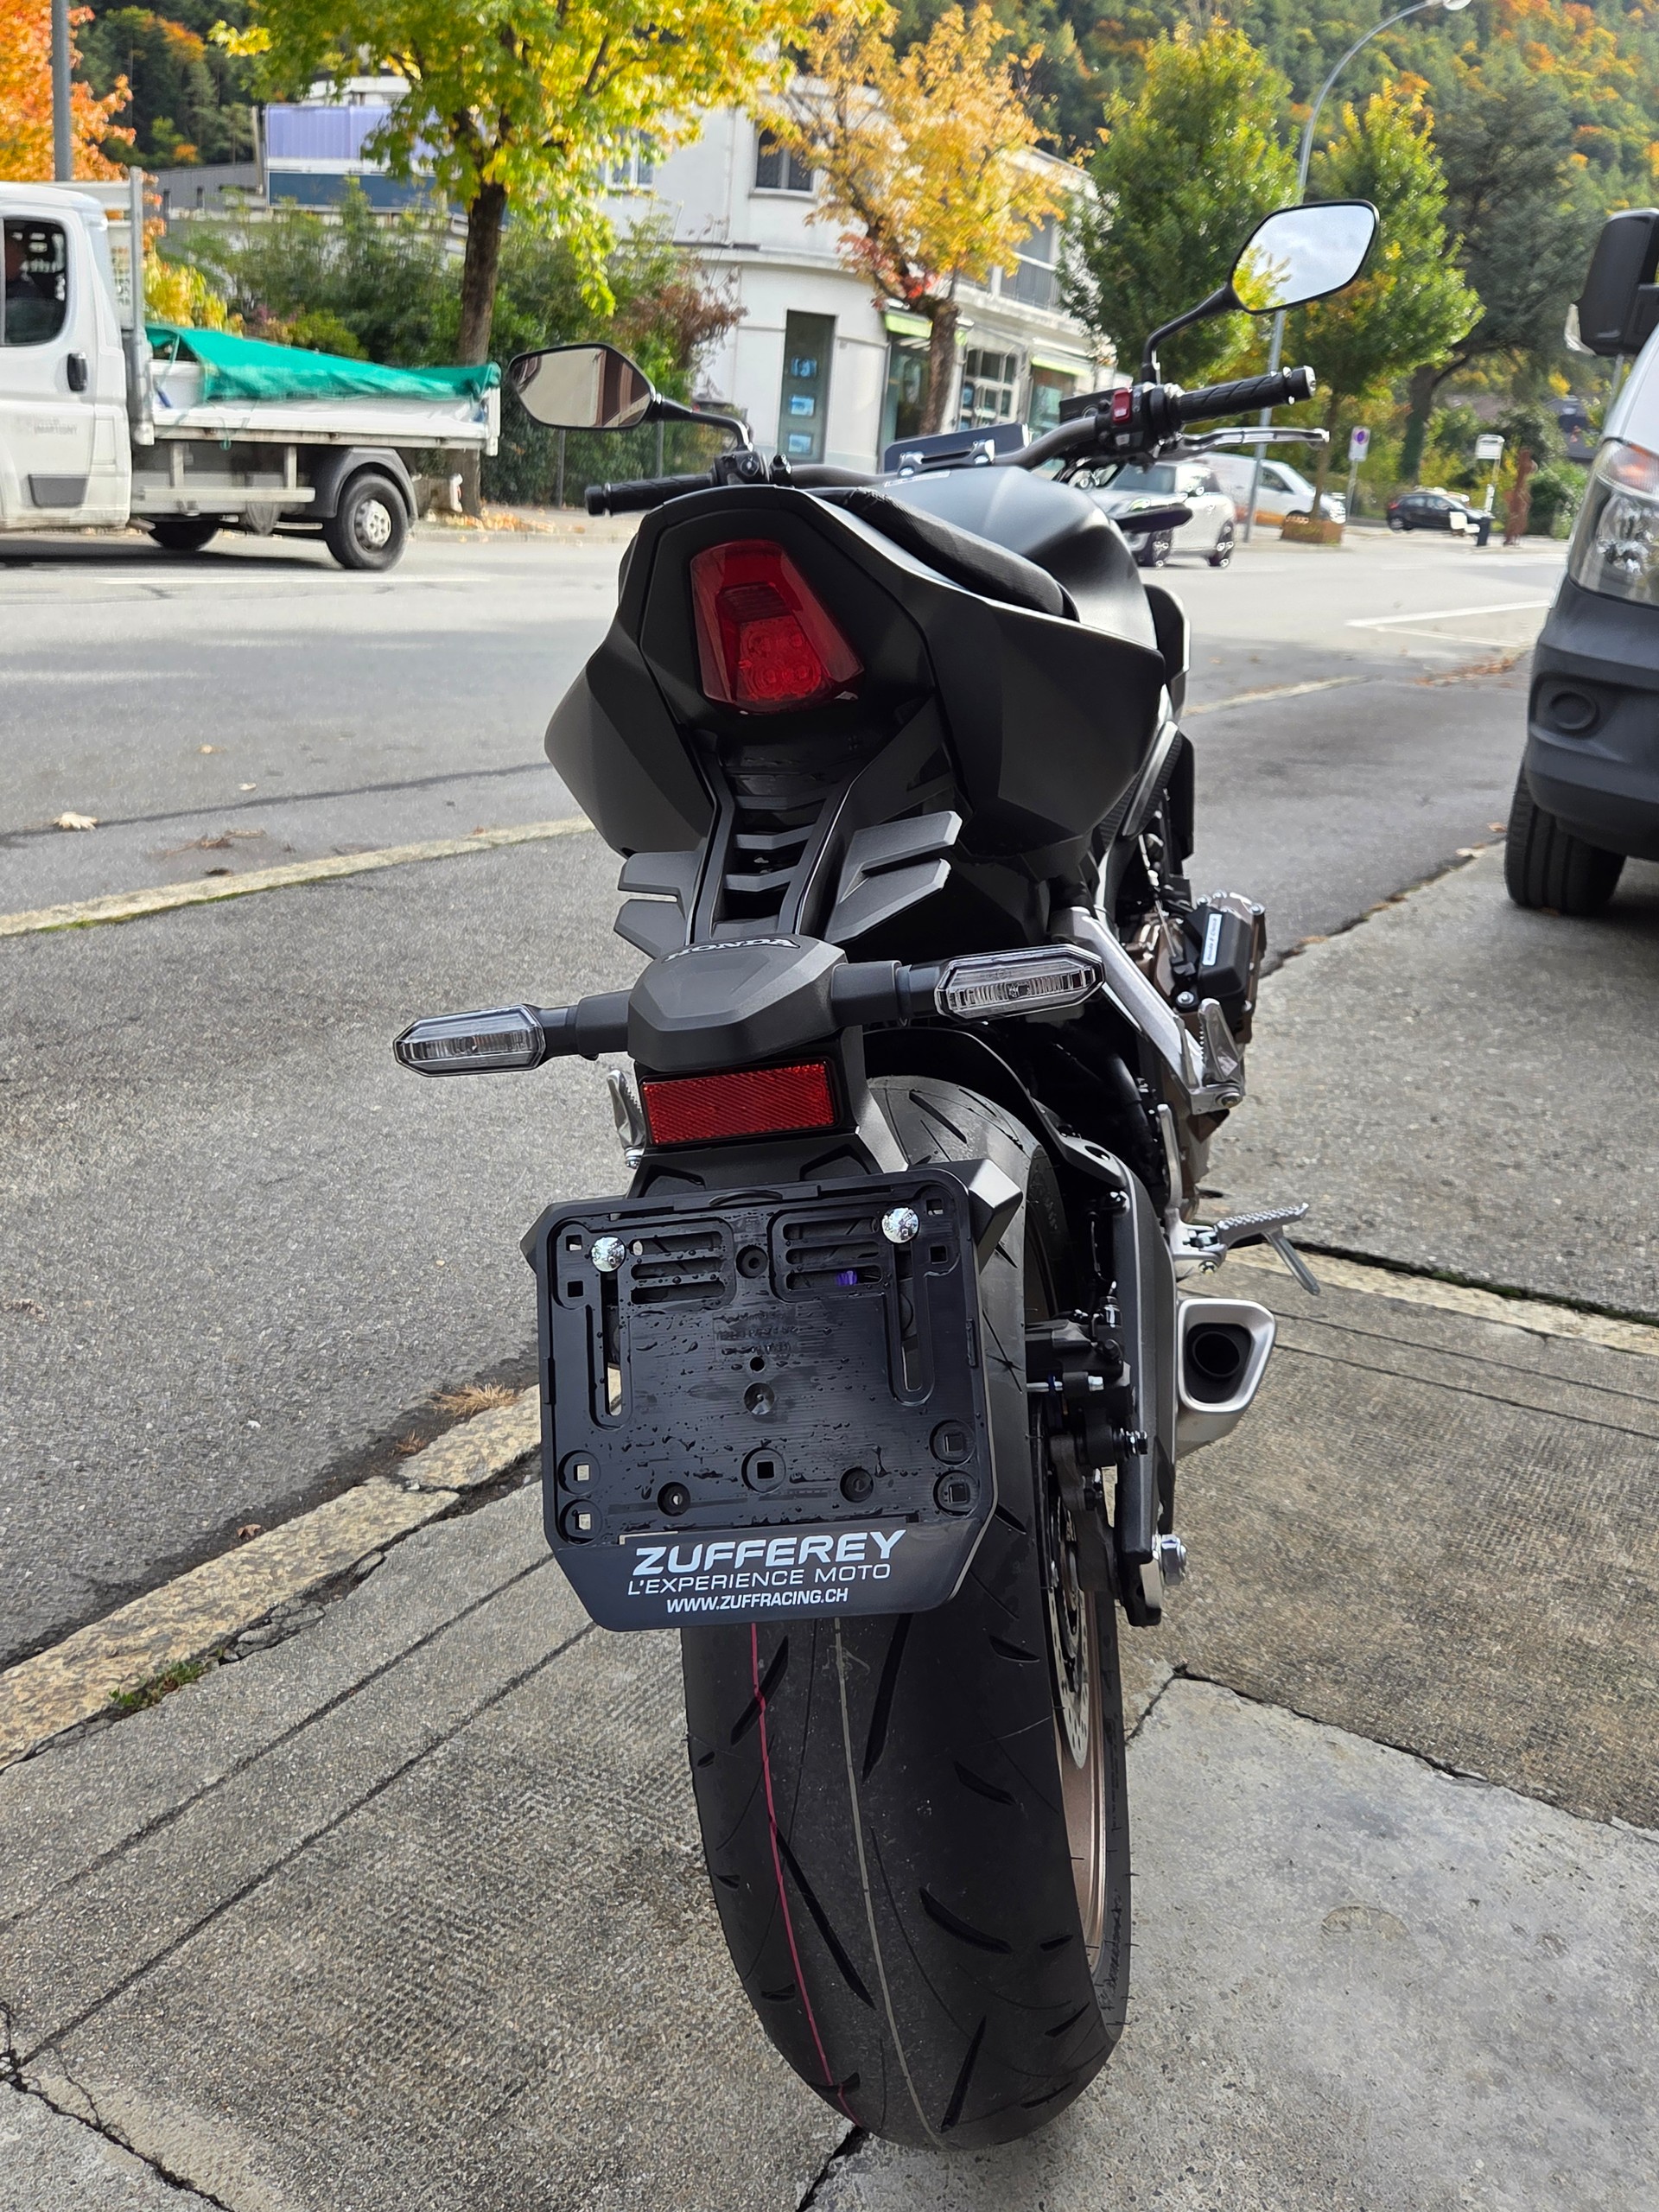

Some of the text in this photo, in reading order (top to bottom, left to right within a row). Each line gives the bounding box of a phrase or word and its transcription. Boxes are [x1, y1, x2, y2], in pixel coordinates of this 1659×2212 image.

[664, 938, 798, 963] HONDA
[632, 1529, 907, 1576] ZUFFEREY
[627, 1563, 891, 1596] L'EXPERIENCE MOTO
[666, 1587, 849, 1613] WWW.ZUFFRACING.CH
